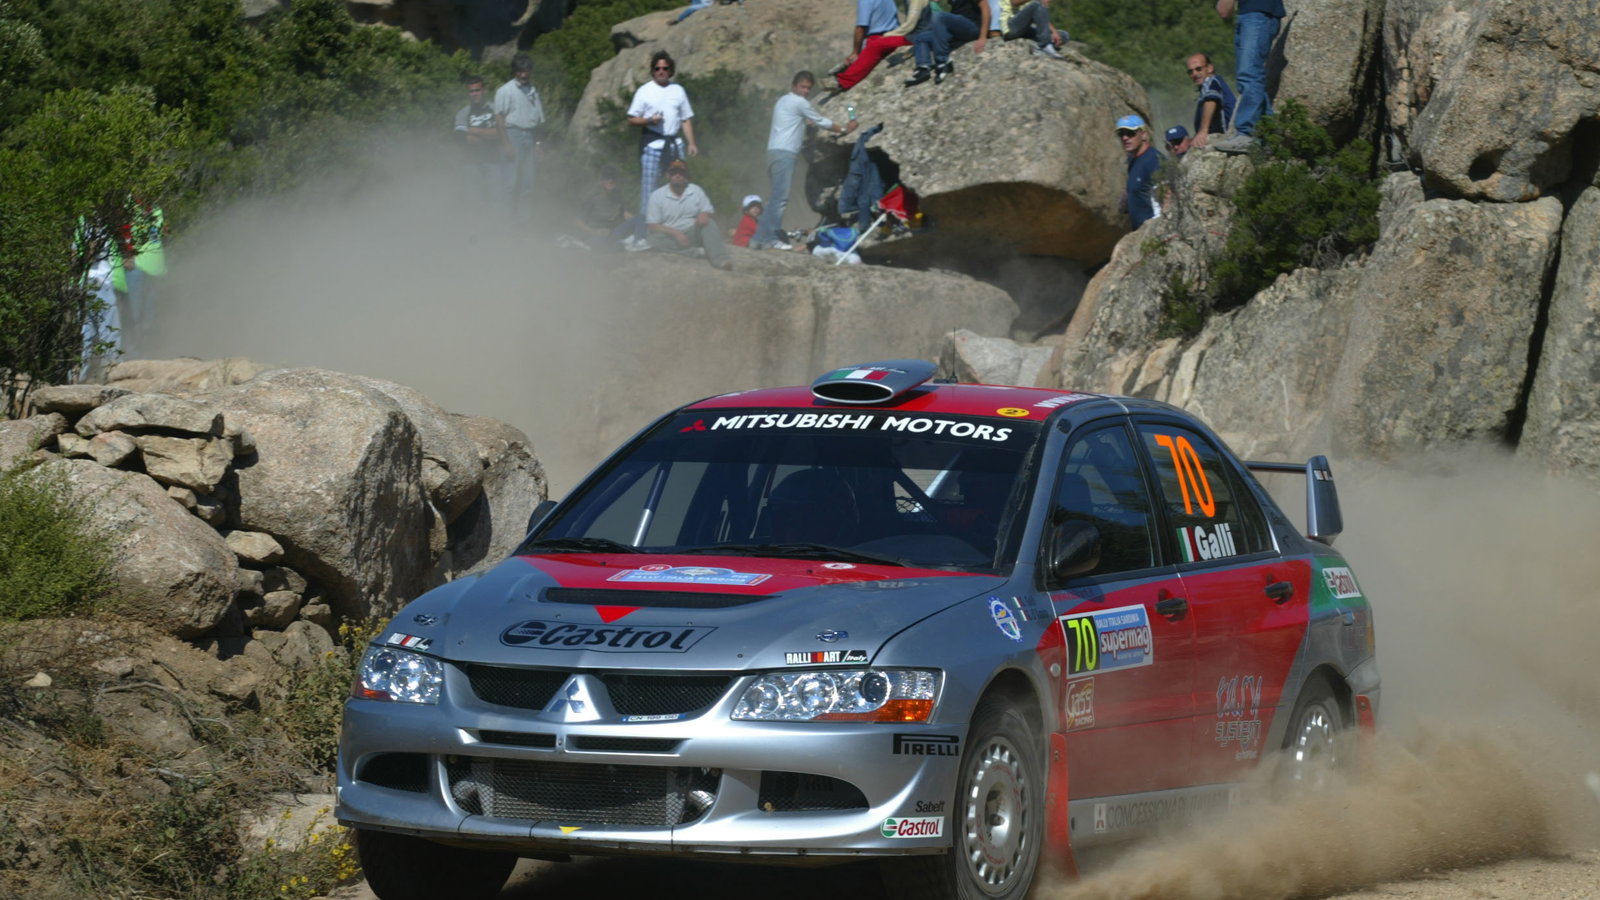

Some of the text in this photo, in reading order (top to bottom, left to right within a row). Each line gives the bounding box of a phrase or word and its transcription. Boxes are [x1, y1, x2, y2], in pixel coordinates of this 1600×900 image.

[711, 414, 1013, 442] MITSUBISHI MOTORS
[1154, 433, 1216, 518] 70
[1194, 522, 1237, 561] Galli
[539, 624, 696, 650] Castrol
[1067, 618, 1097, 672] 70
[1100, 626, 1151, 659] supermag
[846, 654, 867, 662] Italy
[893, 733, 960, 757] PIRELLI
[915, 800, 946, 813] Sabelt
[897, 818, 940, 837] Castrol
